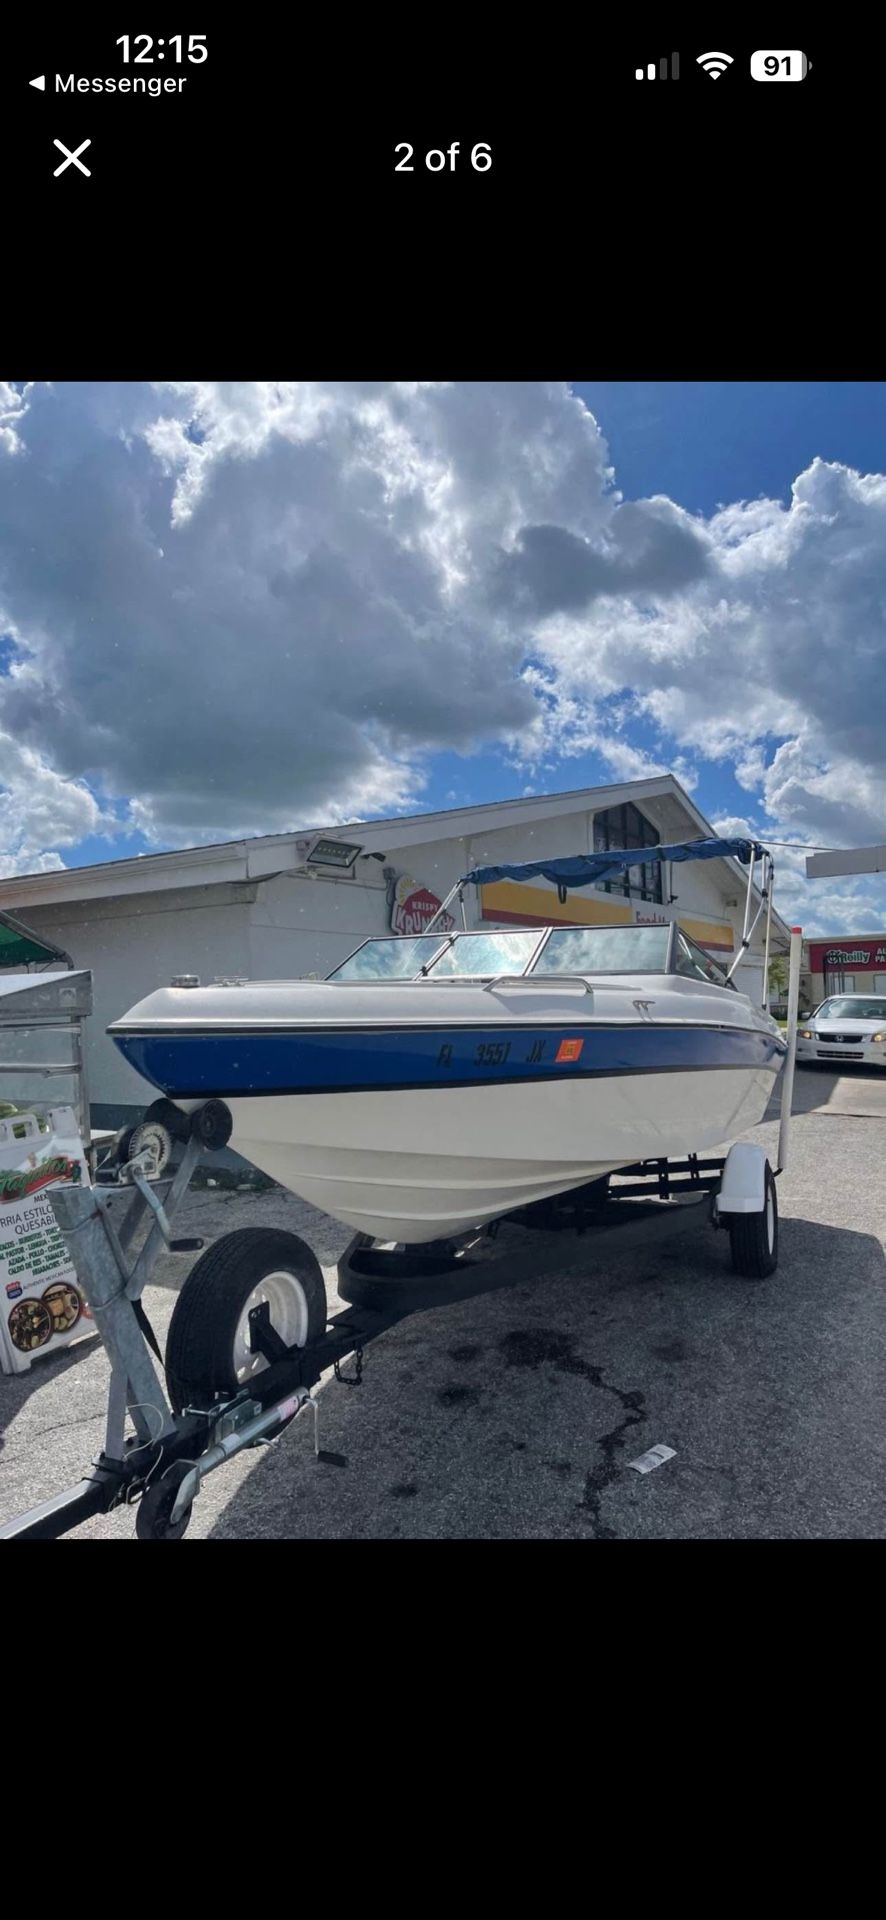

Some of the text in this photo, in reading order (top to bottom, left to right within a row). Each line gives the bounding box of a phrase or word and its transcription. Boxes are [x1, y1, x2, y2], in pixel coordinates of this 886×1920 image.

[411, 901, 439, 912] KRISPY
[438, 1044, 453, 1068] FL
[526, 1039, 546, 1062] JX
